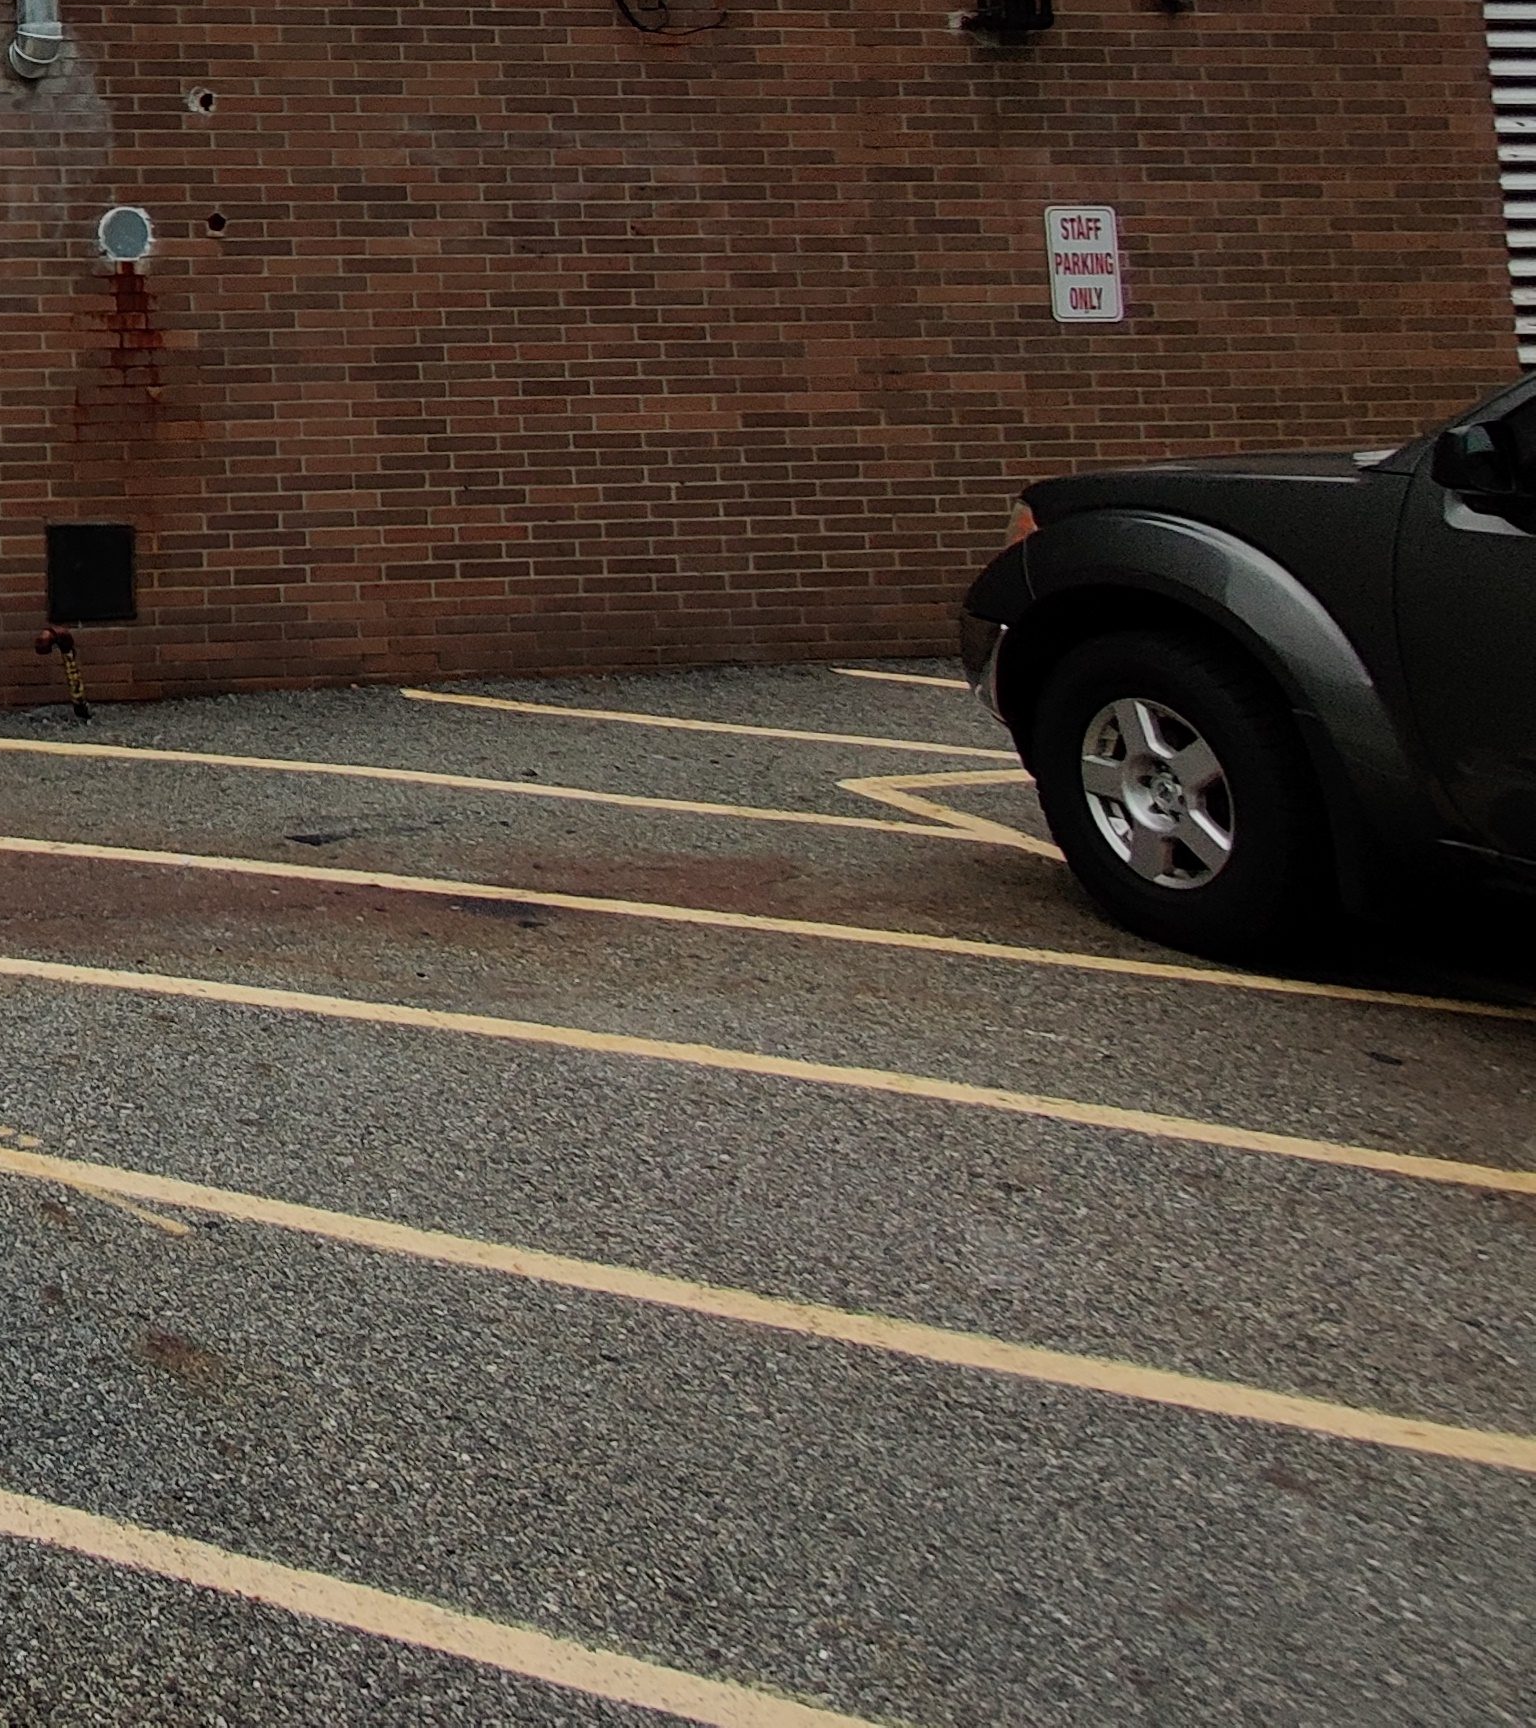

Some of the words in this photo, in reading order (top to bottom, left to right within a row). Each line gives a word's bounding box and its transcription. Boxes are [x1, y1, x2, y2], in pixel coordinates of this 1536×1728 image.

[1060, 215, 1102, 240] STAFF
[1054, 252, 1114, 275] PARKING
[1070, 287, 1103, 310] ONLY
